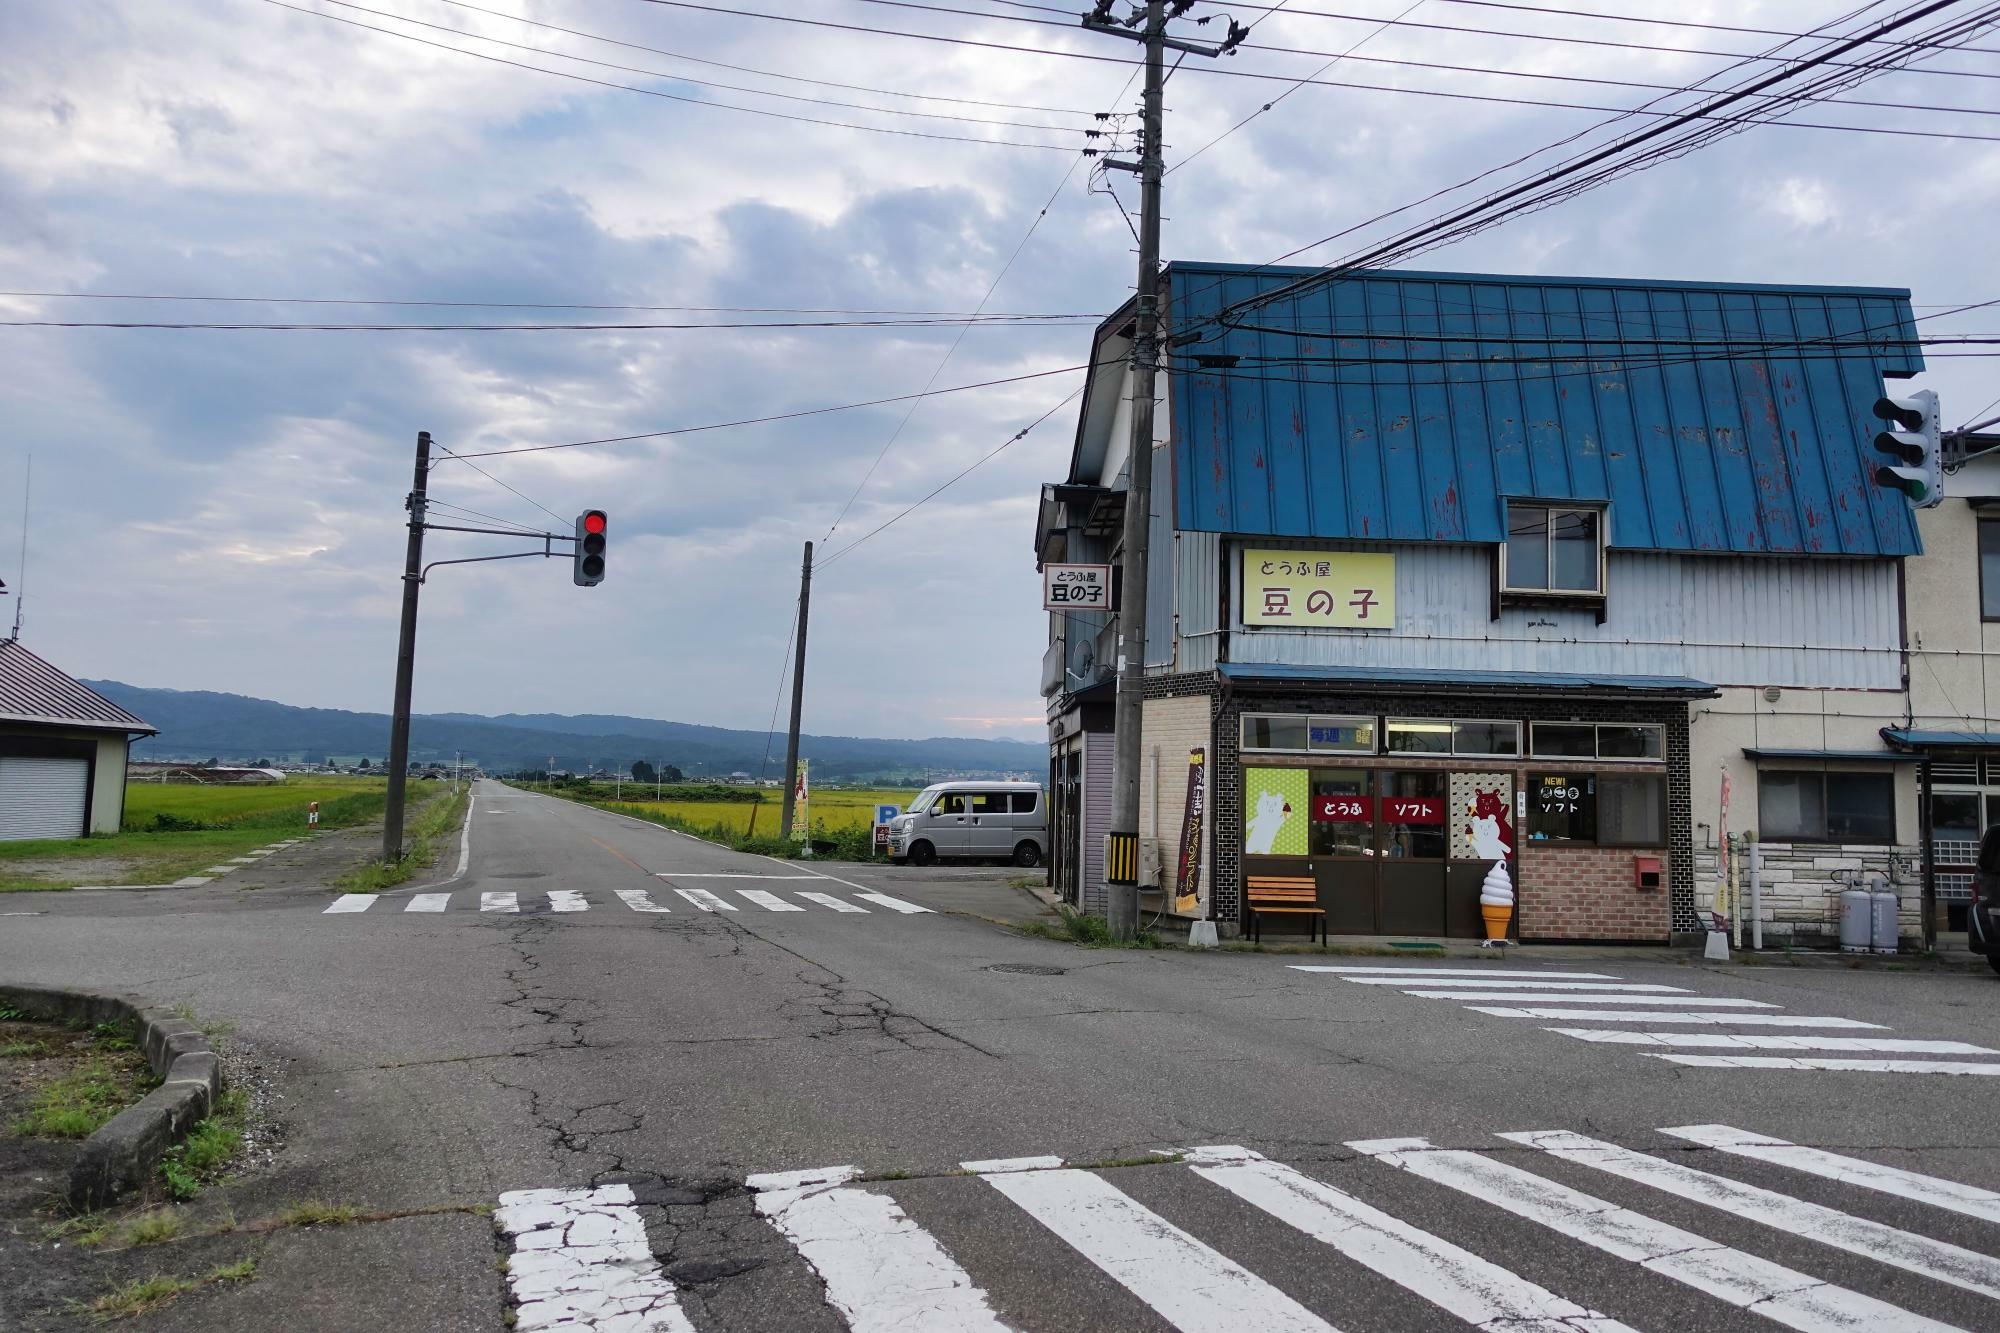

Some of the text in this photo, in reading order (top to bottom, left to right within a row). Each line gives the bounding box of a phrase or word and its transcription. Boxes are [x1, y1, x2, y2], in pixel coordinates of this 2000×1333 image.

[1260, 560, 1331, 577] とうふ屋
[1057, 571, 1097, 583] とうふ屋
[1051, 583, 1103, 602] 豆の子
[1261, 587, 1379, 619] 豆の子
[1544, 776, 1566, 786] NEW!
[879, 806, 897, 823] P
[1324, 802, 1363, 816] とうふ
[1394, 803, 1432, 817] ソフト
[1541, 803, 1578, 813] ソフト
